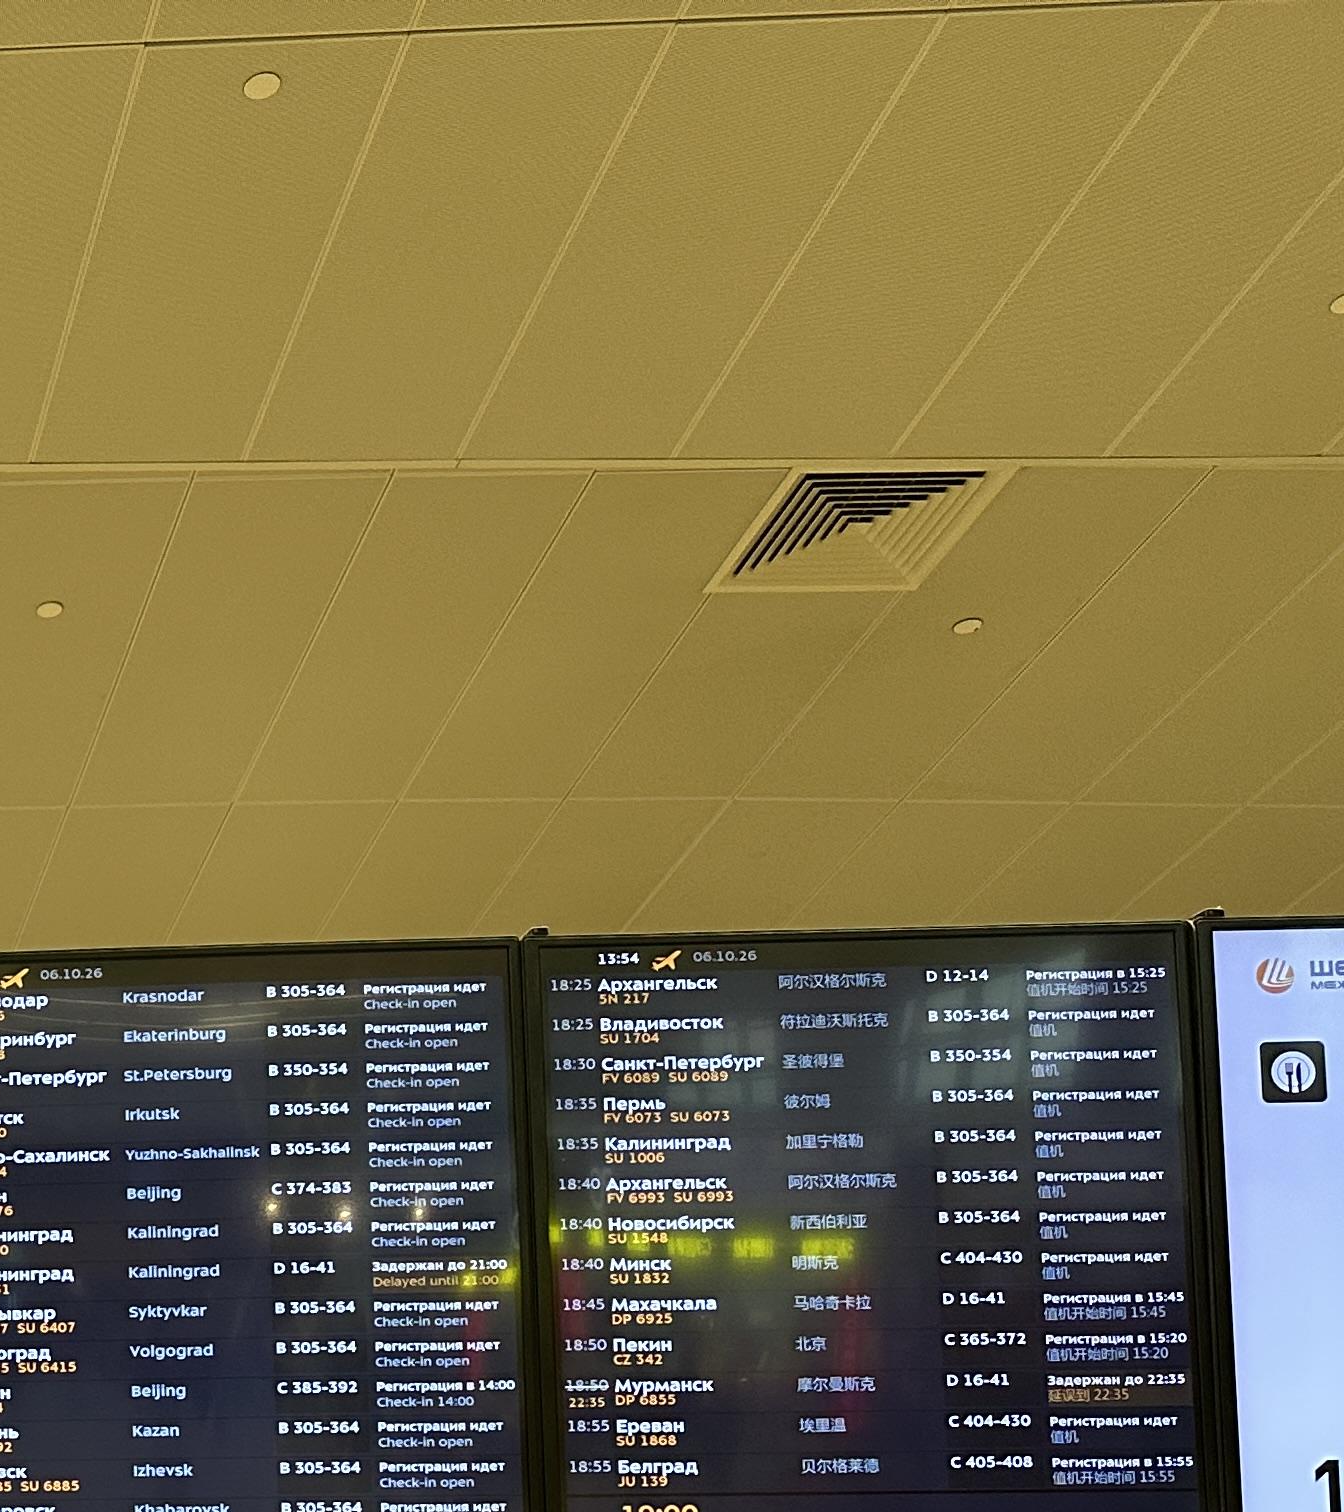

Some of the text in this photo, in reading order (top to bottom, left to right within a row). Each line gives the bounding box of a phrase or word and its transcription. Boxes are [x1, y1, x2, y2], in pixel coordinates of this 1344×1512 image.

[927, 969, 988, 982] D 12-14
[267, 984, 345, 997] B 305-364
[552, 979, 591, 991] 18:25
[598, 979, 717, 994] Архангельск
[123, 990, 204, 1003] Krasnodar
[624, 992, 649, 1004] 217
[127, 1186, 181, 1202] Beijing
[372, 1259, 507, 1273] Задержан до 21:00
[613, 1338, 672, 1352] Пекин
[796, 1337, 826, 1351] 北京
